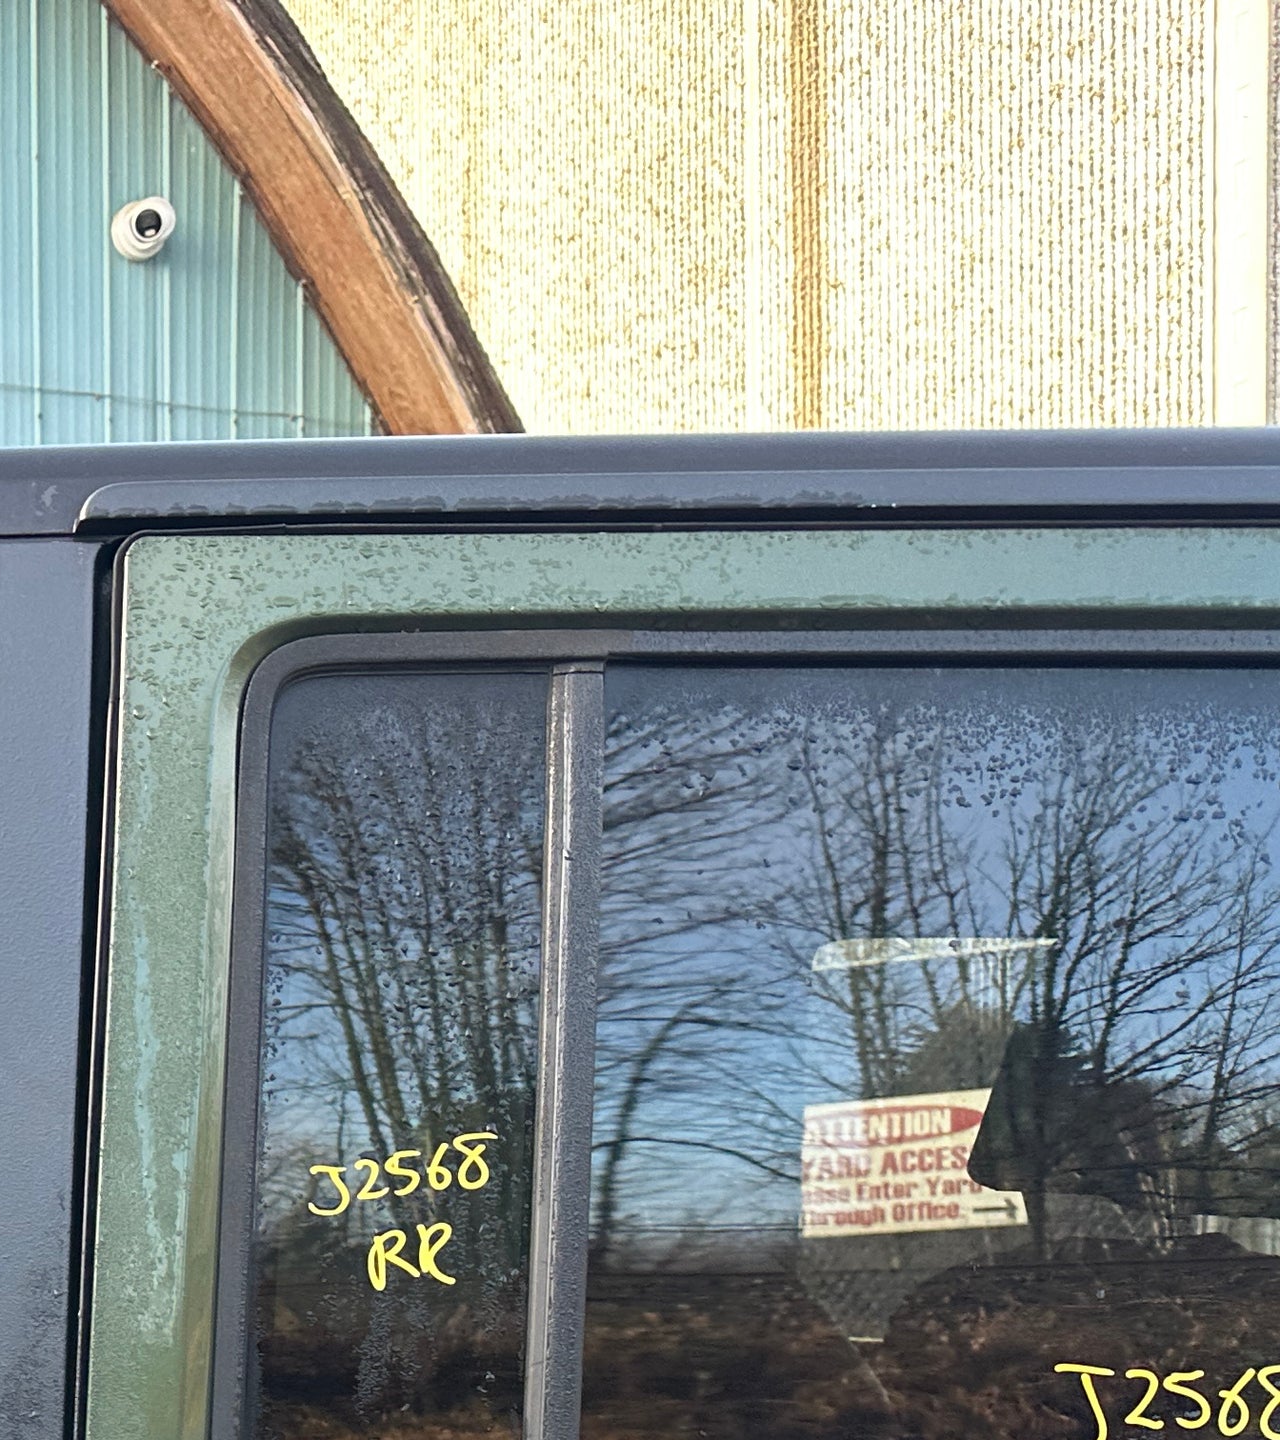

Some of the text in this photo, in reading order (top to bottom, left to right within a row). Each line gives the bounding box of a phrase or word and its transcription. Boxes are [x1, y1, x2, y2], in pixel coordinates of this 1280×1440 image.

[307, 1132, 498, 1217] J2568
[855, 1181, 919, 1200] Enter
[367, 1222, 456, 1292] RR
